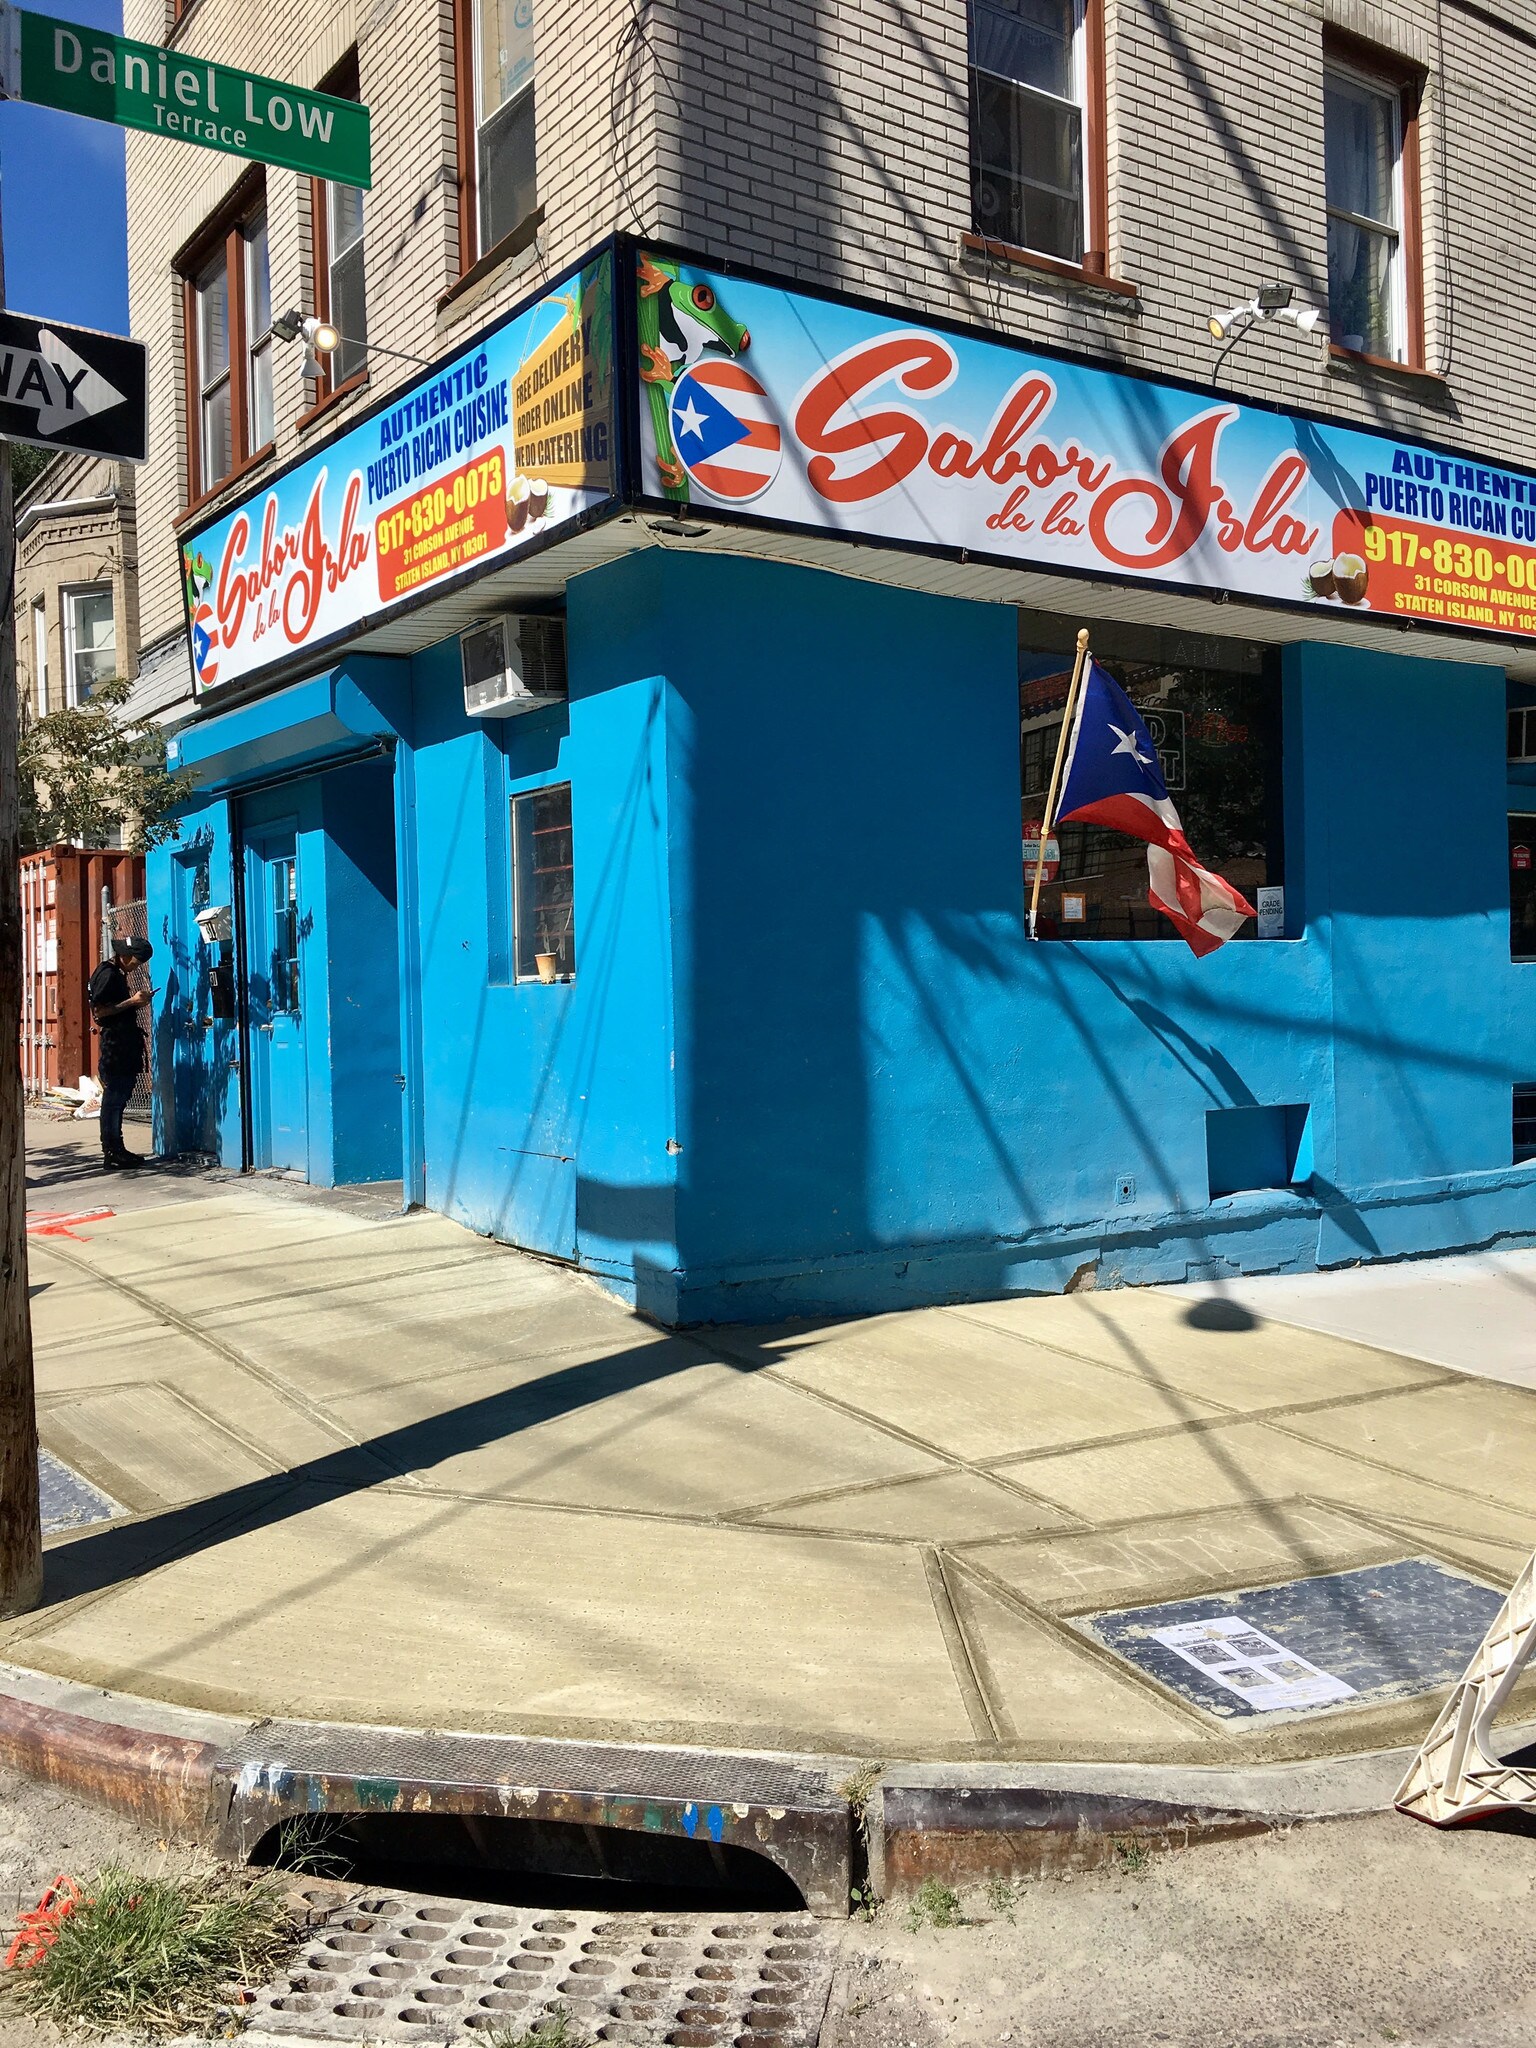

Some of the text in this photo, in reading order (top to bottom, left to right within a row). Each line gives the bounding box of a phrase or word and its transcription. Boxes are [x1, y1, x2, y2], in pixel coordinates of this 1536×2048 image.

[54, 29, 335, 144] Daniel Low
[153, 104, 248, 149] Terrace
[516, 316, 593, 409] FREE DELIVERY
[380, 352, 488, 451] AUTHENTIC
[517, 371, 593, 438] ORDER ONLINE
[367, 378, 508, 505] PUERTO RICAN CUISINE
[515, 421, 608, 468] WE DO CATERING
[796, 338, 1319, 569] Sabor de la Isla
[1365, 472, 1536, 543] PUERTO RICAN CU
[1391, 449, 1536, 506] AUTHENTI
[216, 474, 371, 649] Sabor de la Isla
[395, 531, 488, 592] STATEN ISLAND, NY 10301
[403, 514, 475, 566] 31 CORSON AVENUE
[1365, 525, 1536, 591] 917•830•00
[1394, 592, 1536, 631] STATEN ISLAND, NY 103
[1415, 574, 1536, 611] 31 CORSON AVENUE
[1173, 639, 1220, 665] ATM
[1259, 907, 1283, 916] PENDING
[1261, 900, 1281, 908] GRADE
